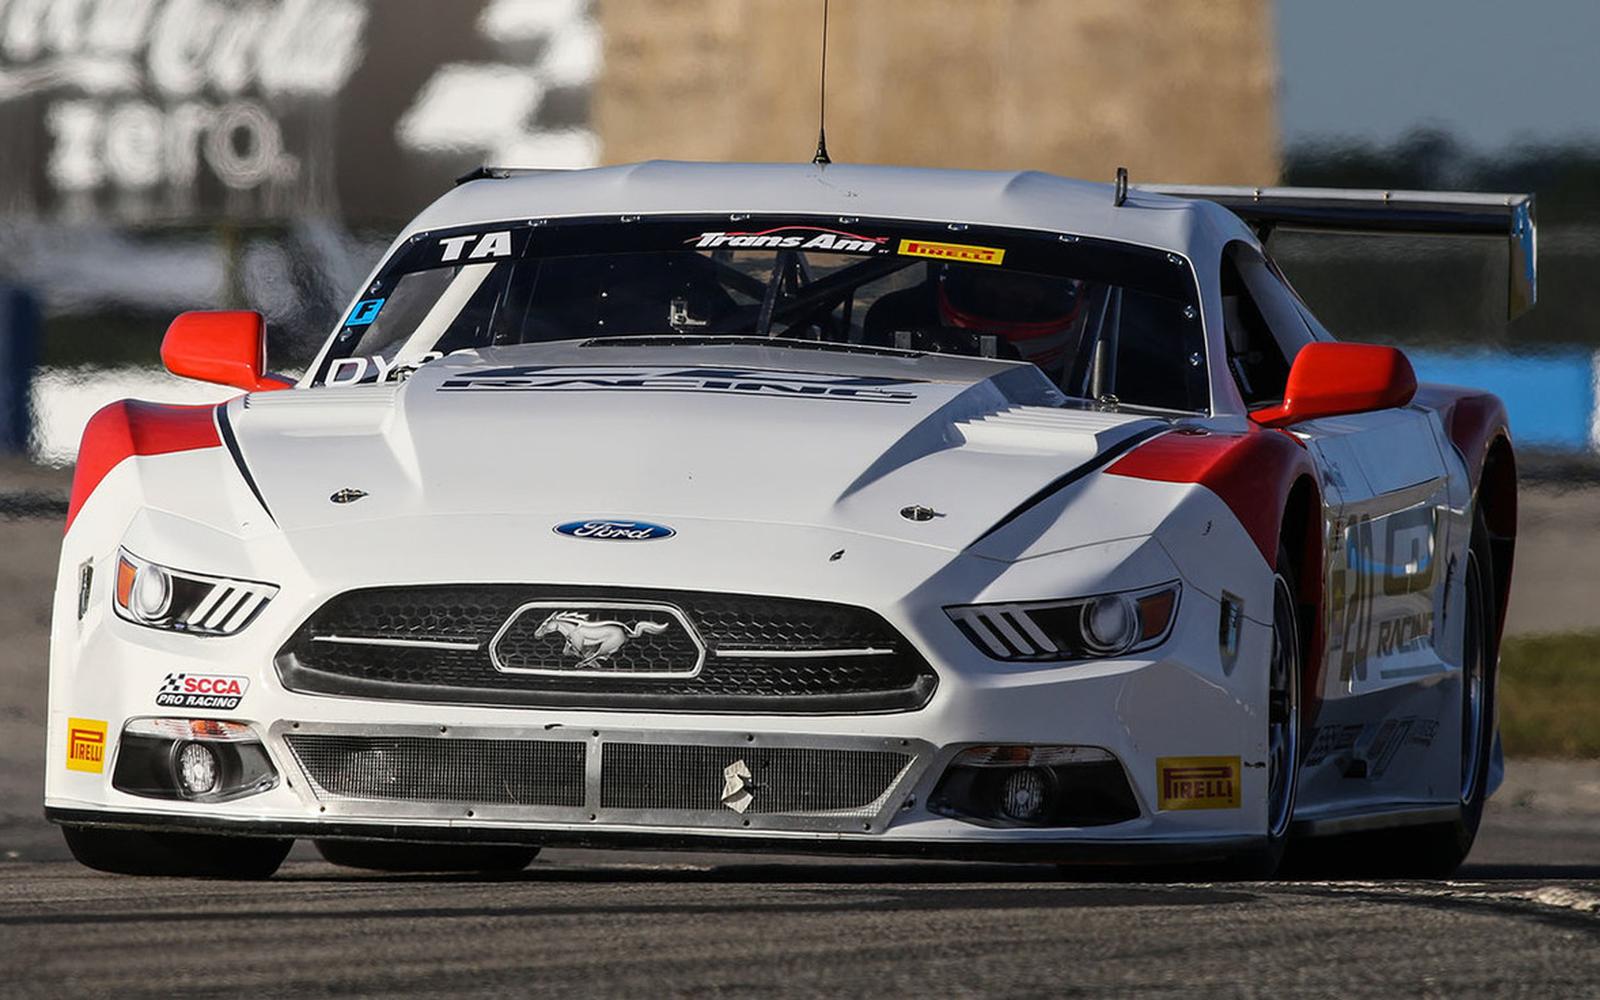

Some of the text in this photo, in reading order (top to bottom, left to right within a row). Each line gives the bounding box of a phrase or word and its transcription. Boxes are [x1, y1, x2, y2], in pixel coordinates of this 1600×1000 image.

[439, 231, 512, 261] TA
[696, 231, 804, 250] Trans
[801, 232, 877, 251] Am
[907, 242, 996, 261] PIRELLI
[355, 301, 377, 319] F
[442, 379, 918, 399] RACING
[574, 521, 655, 539] Ford
[184, 678, 241, 695] SCCA
[157, 694, 238, 709] PRO RACING
[70, 728, 104, 762] PIRELLI
[1163, 766, 1233, 800] PIRELLI
